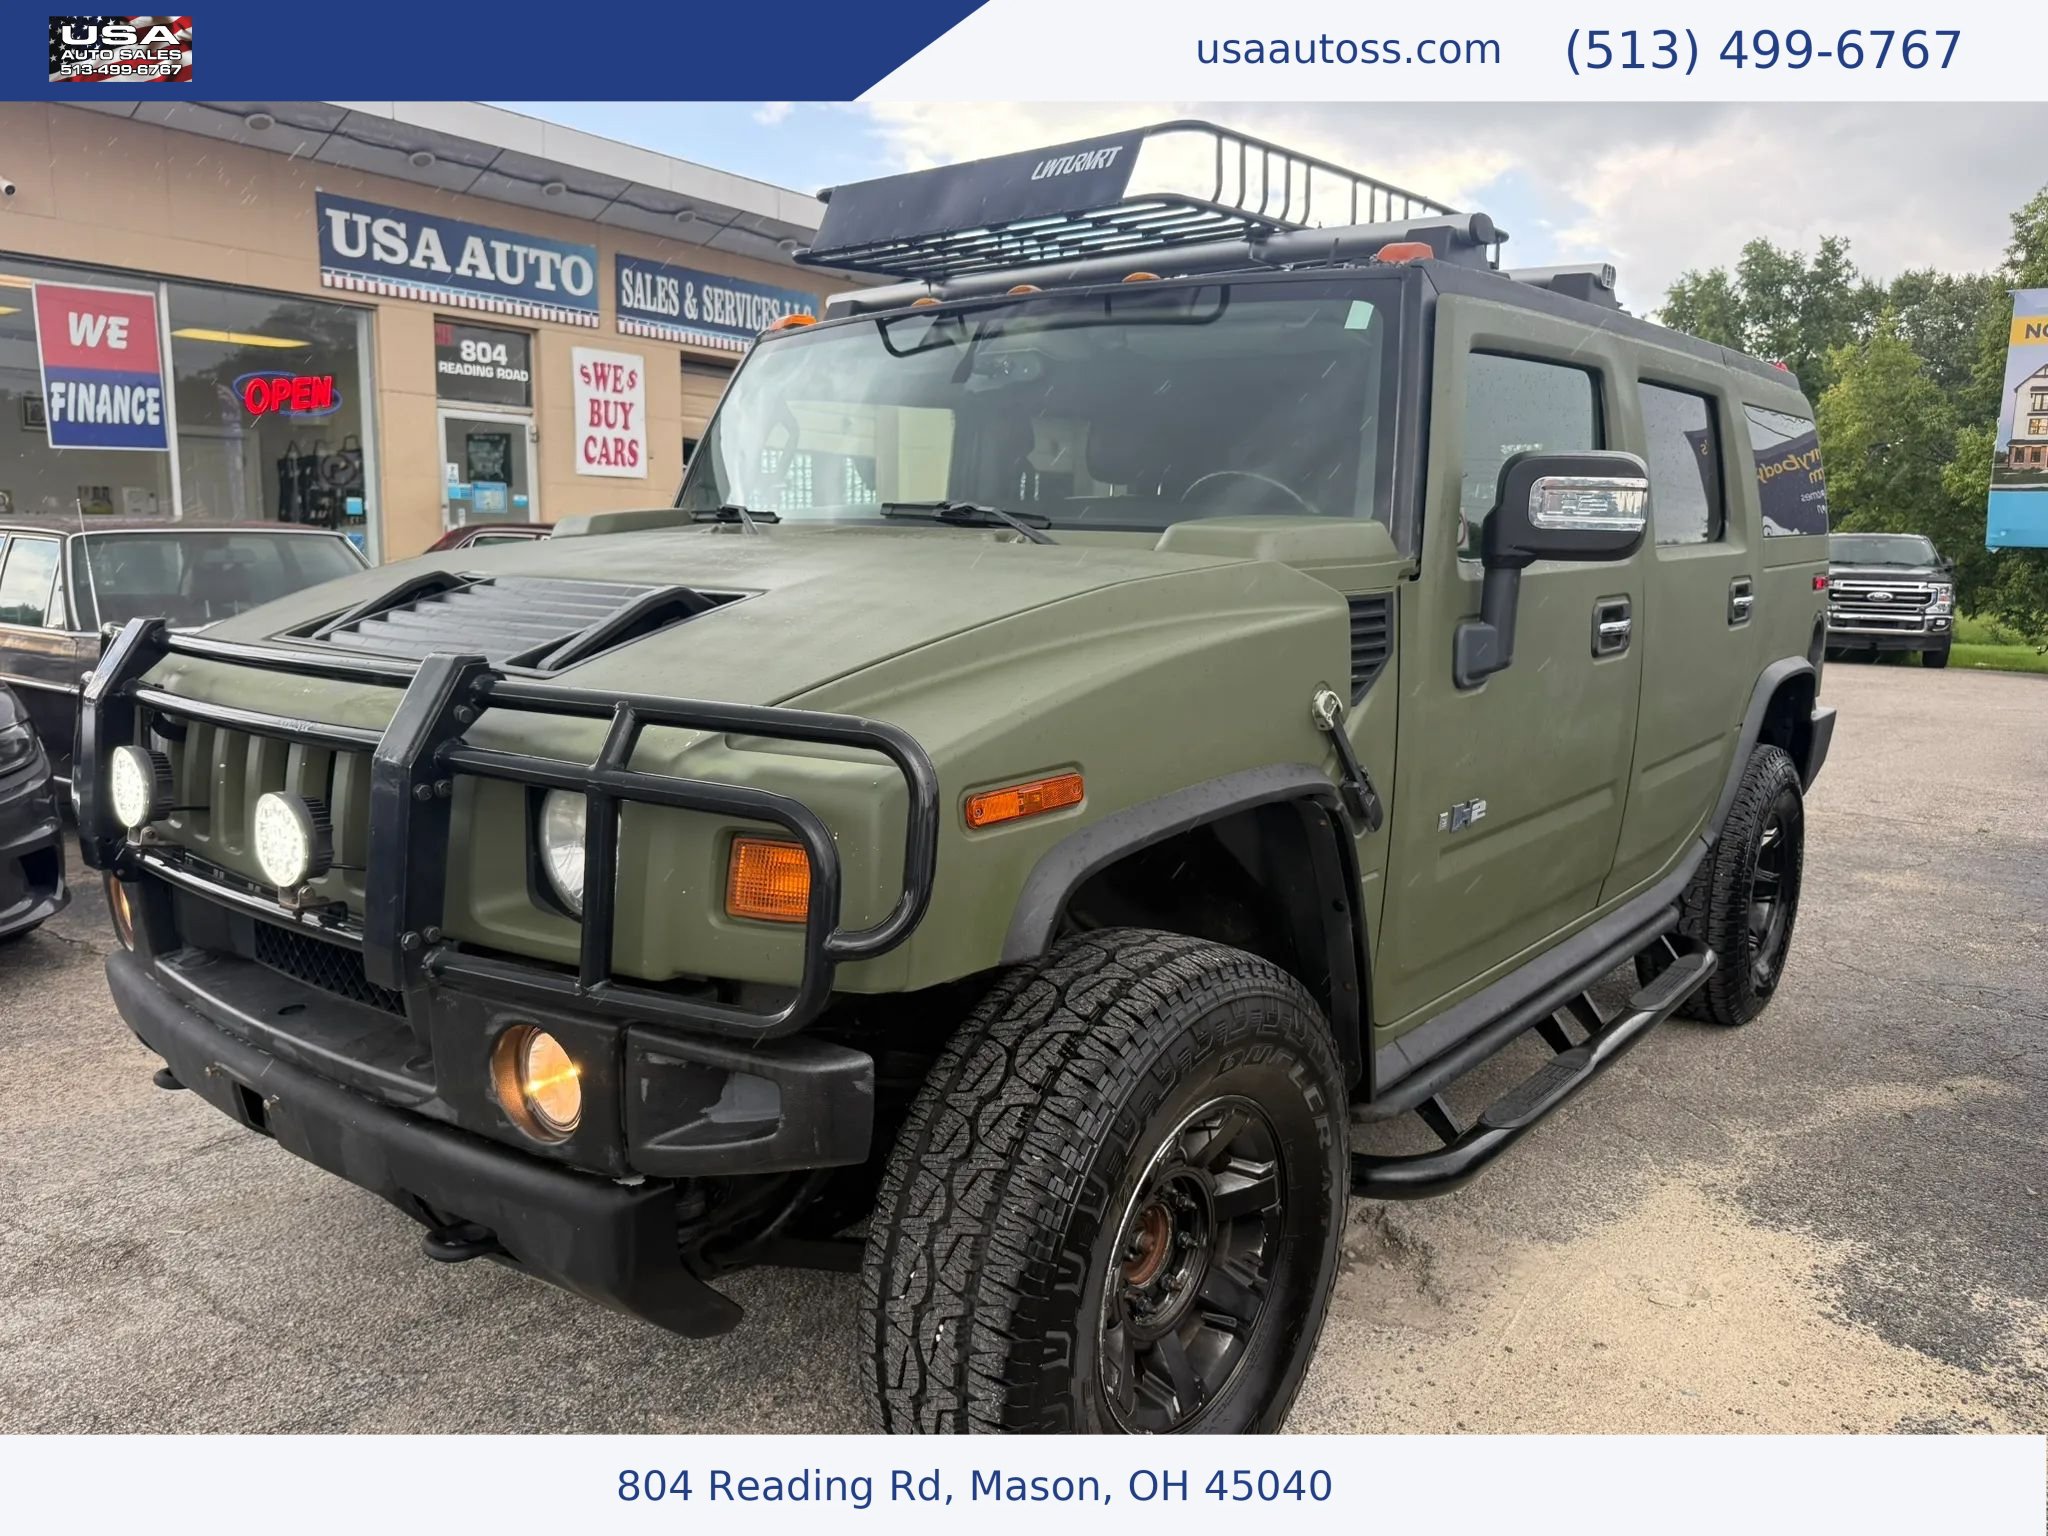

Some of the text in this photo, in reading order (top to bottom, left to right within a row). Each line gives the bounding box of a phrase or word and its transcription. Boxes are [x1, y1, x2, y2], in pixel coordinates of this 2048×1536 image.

[325, 208, 594, 296] USA AUTO
[621, 268, 781, 331] SALES & SERVICES
[68, 311, 130, 349] WE
[438, 360, 529, 382] READING ROAD
[460, 339, 508, 366] 804
[50, 382, 160, 426] FINANCE
[244, 375, 333, 416] OPEN
[589, 398, 634, 431] BUY
[584, 435, 639, 467] CARS
